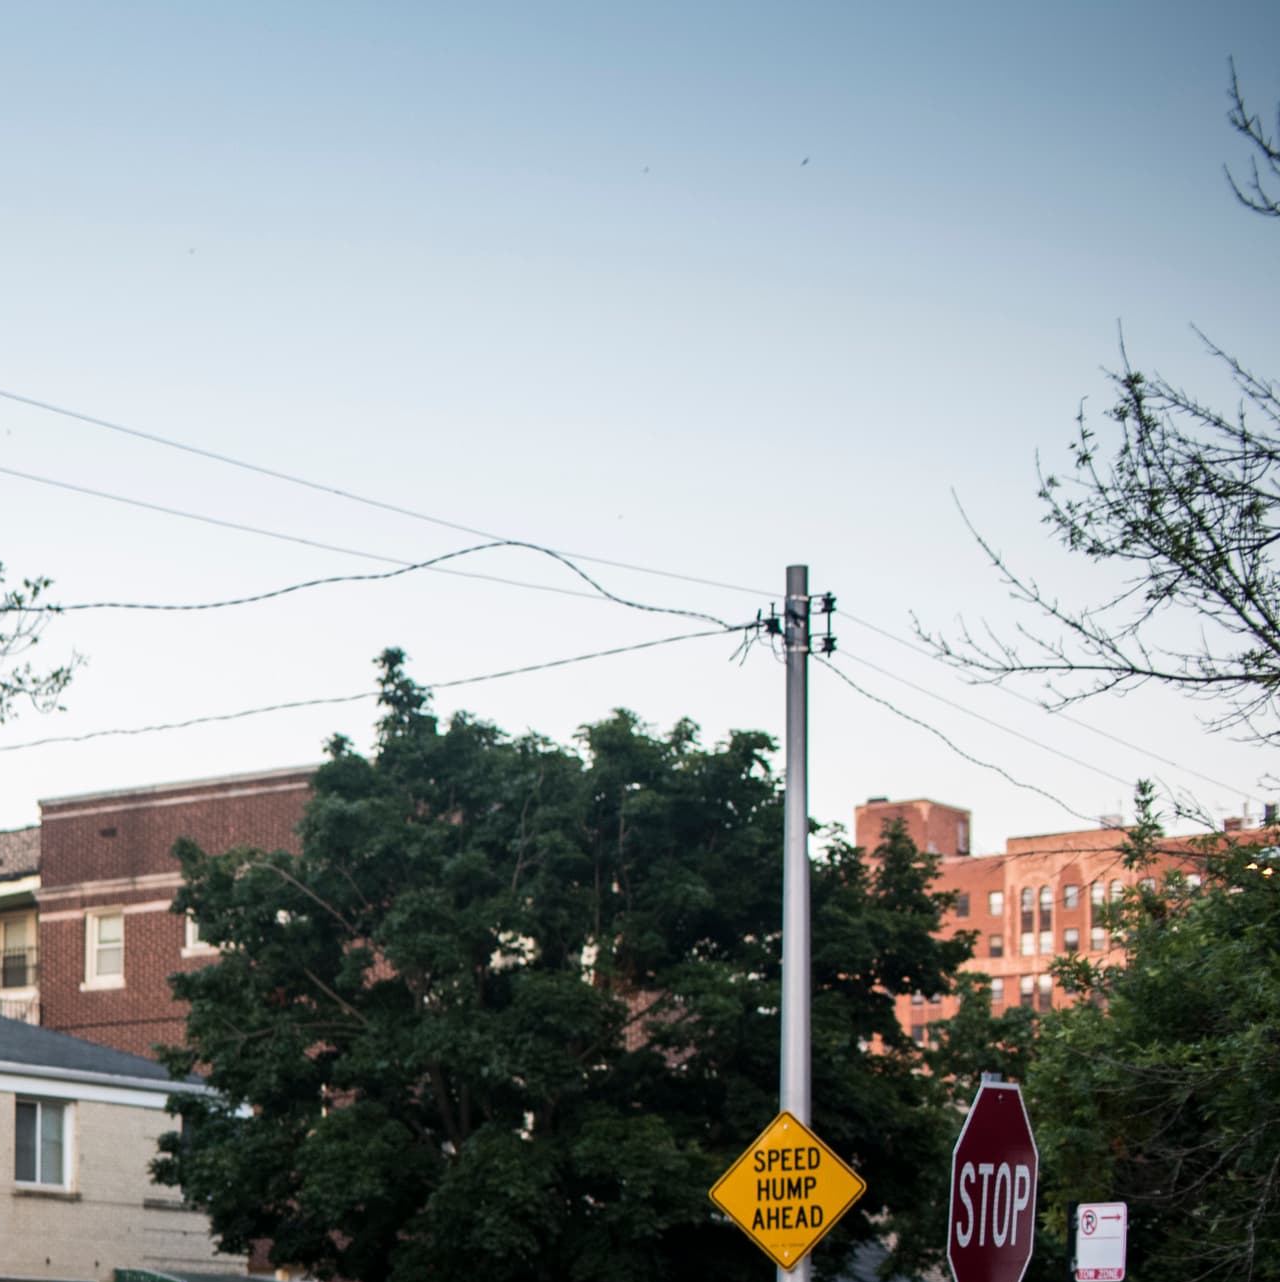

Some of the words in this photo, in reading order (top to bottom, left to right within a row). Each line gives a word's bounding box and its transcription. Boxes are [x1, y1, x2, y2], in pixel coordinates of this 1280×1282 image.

[754, 1147, 821, 1172] SPEED
[757, 1176, 816, 1201] HUMP
[956, 1161, 1030, 1248] STOP
[752, 1205, 823, 1230] AHEAD
[1078, 1269, 1095, 1280] TOW
[1098, 1268, 1119, 1280] ZONE
